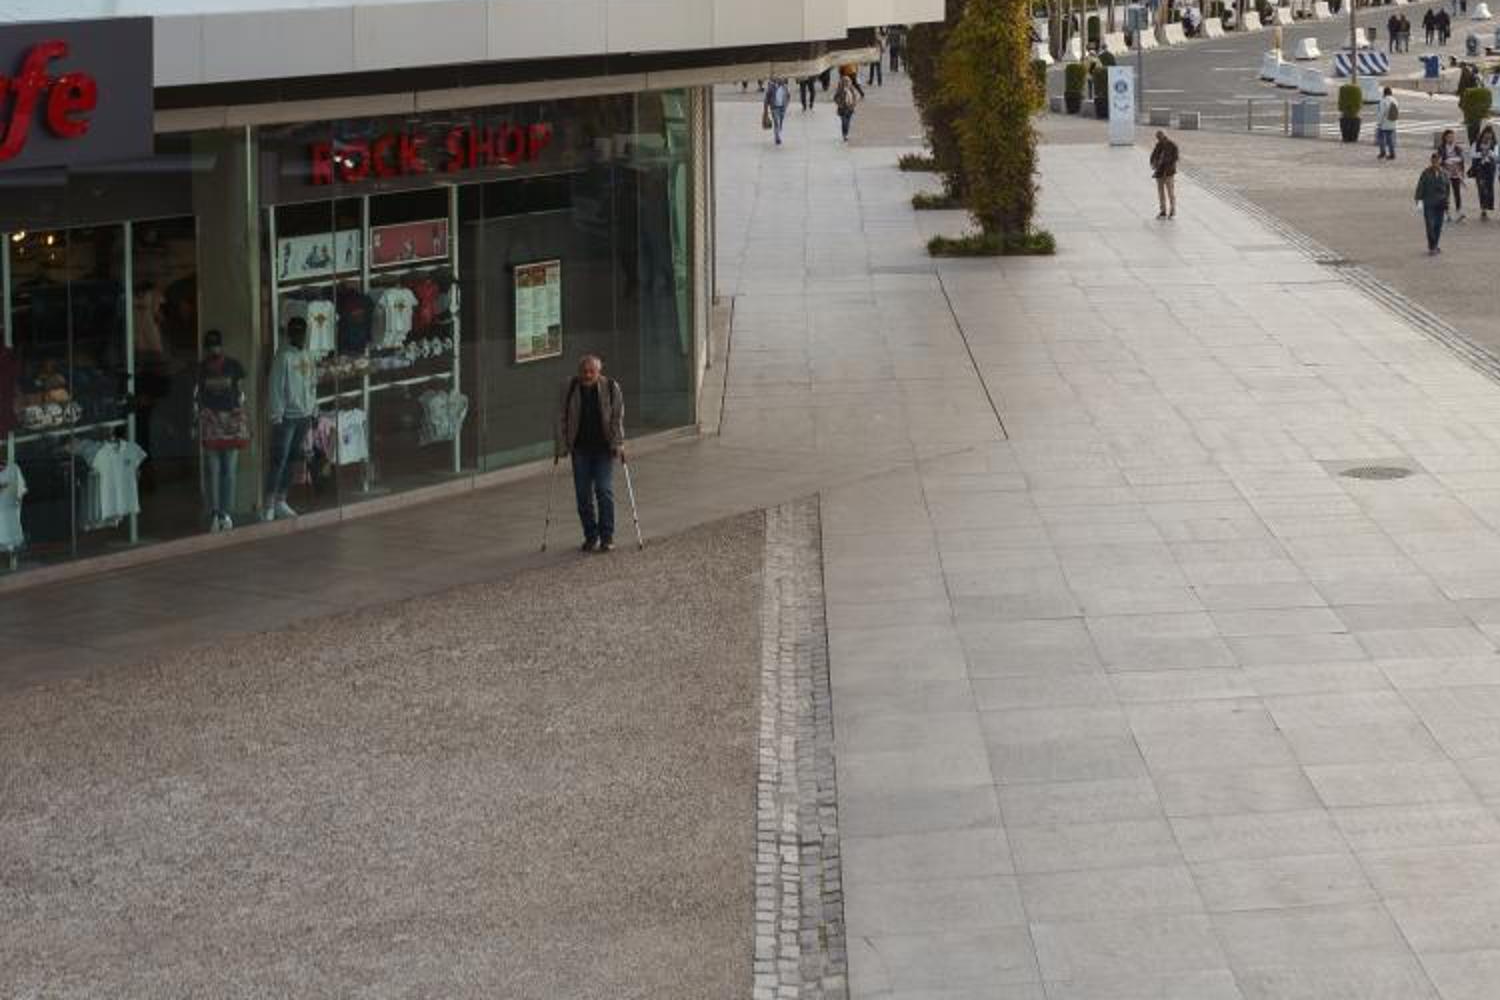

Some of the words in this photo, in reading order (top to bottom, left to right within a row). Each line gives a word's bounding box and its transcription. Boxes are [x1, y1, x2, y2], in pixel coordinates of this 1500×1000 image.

[0, 40, 97, 161] fe
[309, 133, 429, 186] ROCK
[446, 119, 551, 174] SHOP
